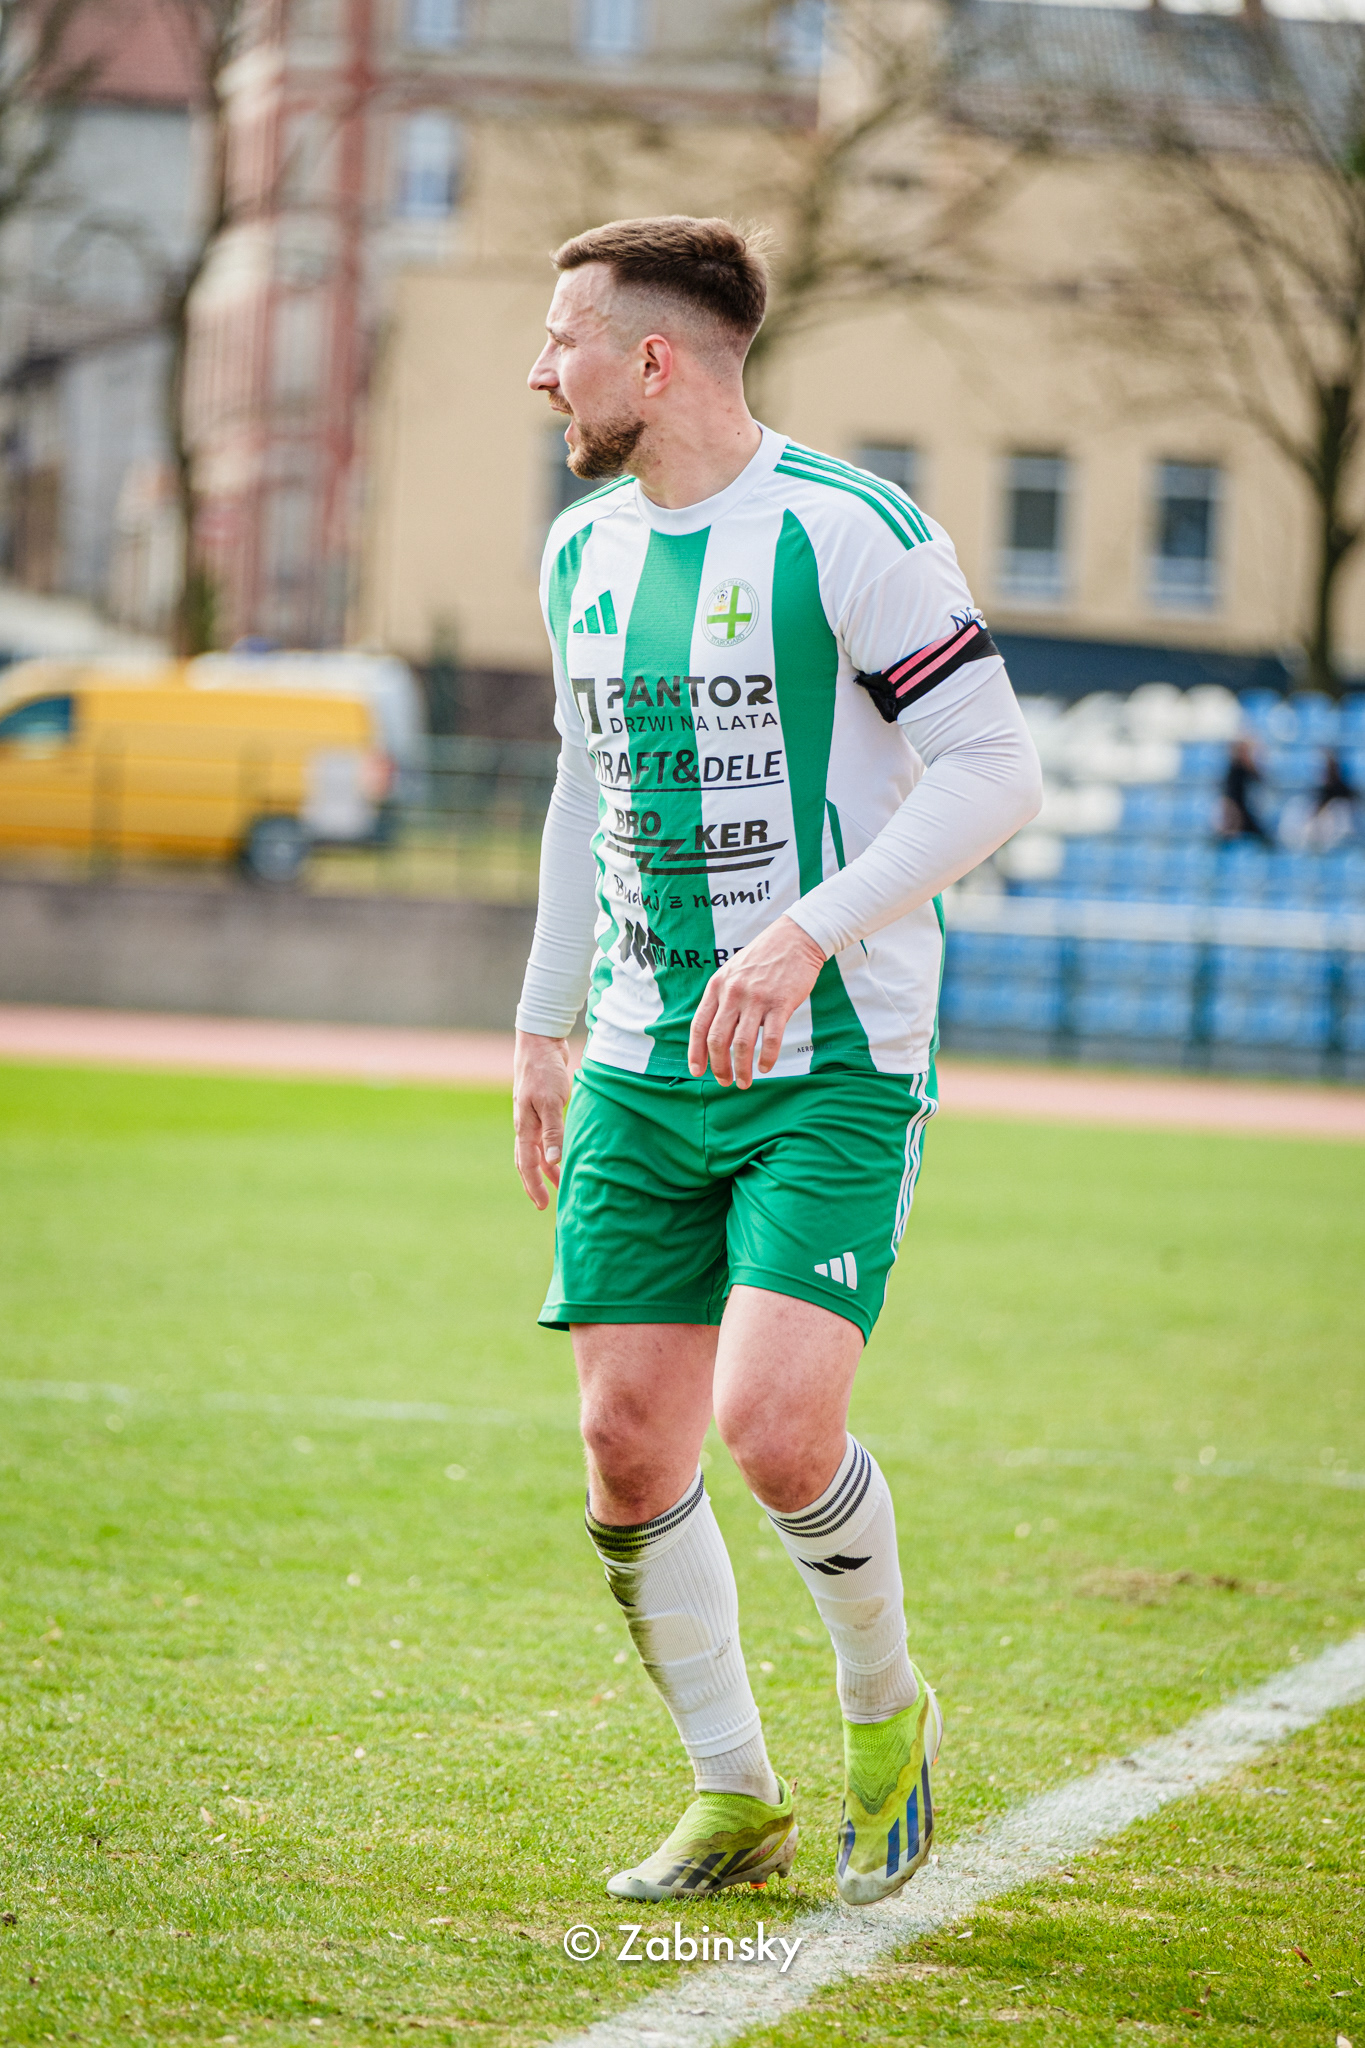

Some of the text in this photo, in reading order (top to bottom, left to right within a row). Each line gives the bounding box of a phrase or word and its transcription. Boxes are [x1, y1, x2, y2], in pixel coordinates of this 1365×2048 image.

[606, 674, 774, 709] PANTOR
[609, 712, 778, 734] DRZWI NA LATA
[614, 873, 771, 911] Buduj z nami!
[650, 944, 746, 969] MAR-B
